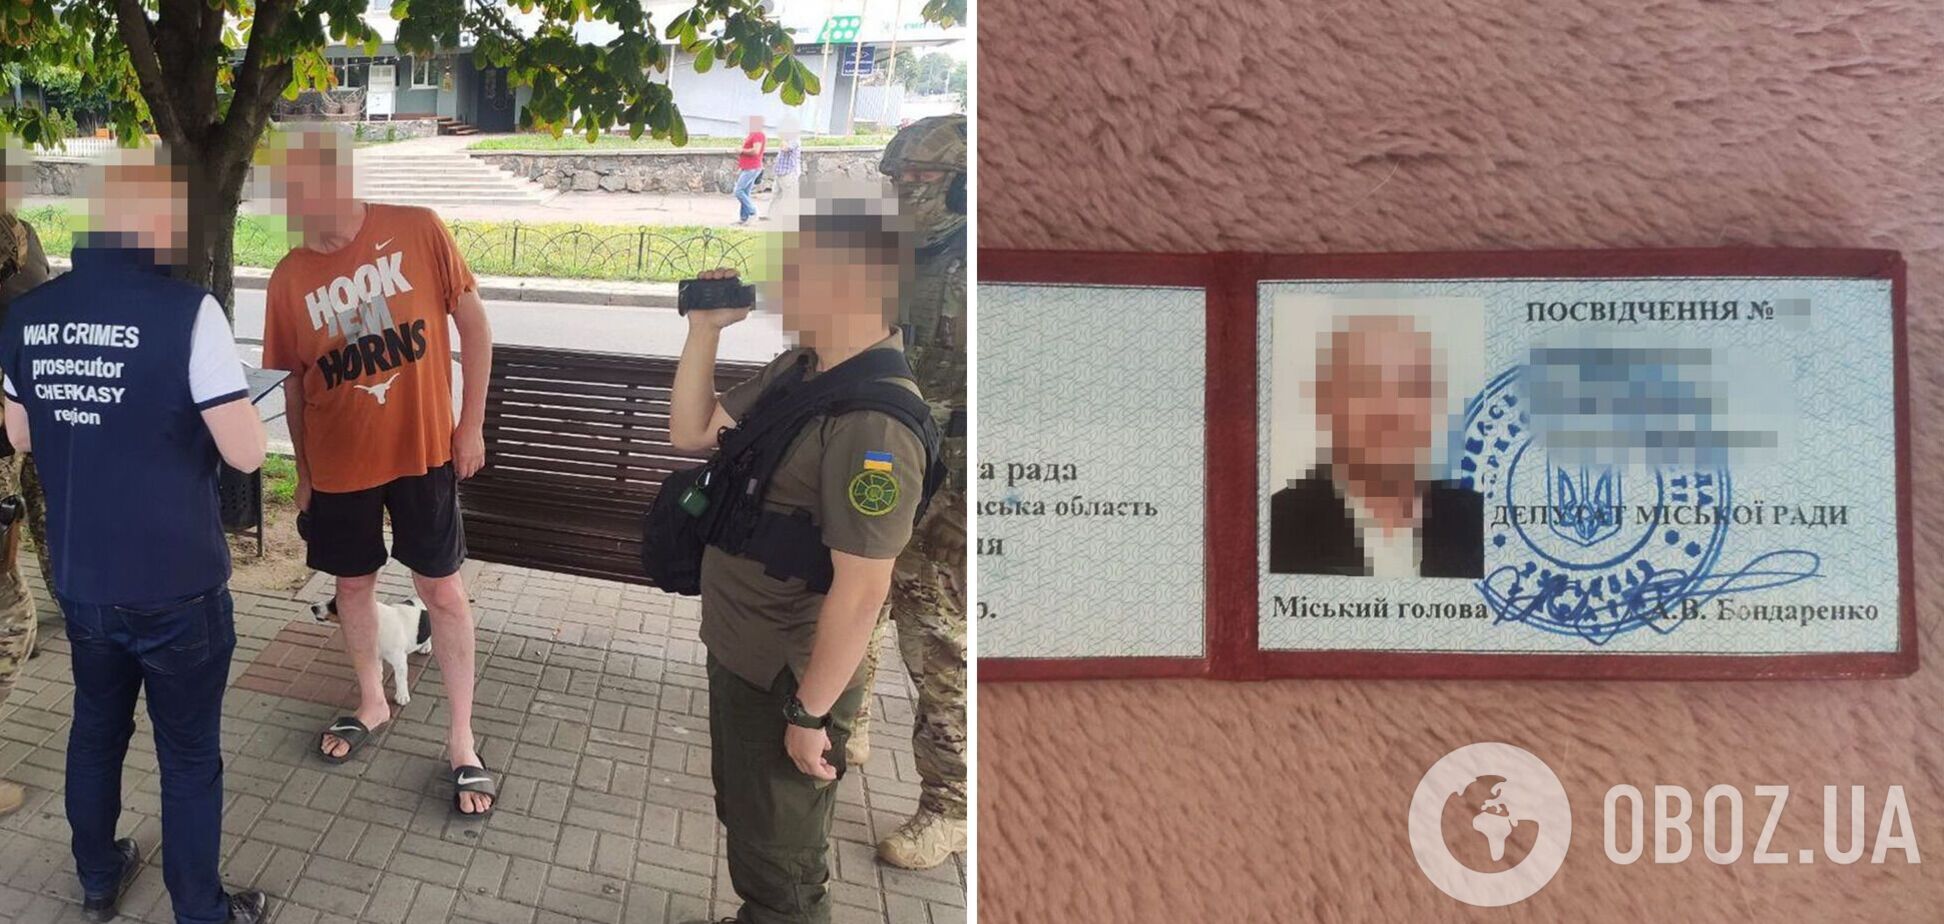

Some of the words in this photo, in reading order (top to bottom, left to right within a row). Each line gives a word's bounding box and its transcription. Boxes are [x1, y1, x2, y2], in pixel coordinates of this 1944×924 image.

[304, 252, 414, 331] HOOK
[1527, 300, 1738, 324] ПОСВІДЧЕННЯ
[23, 323, 59, 346] WAR
[62, 323, 140, 348] CRIMES
[32, 356, 125, 379] prosecutor
[316, 319, 427, 391] HORNS
[35, 383, 126, 403] CHERKASY
[977, 462, 995, 480] а
[1007, 462, 1078, 487] рада
[1055, 495, 1159, 517] область
[1491, 505, 1627, 528] ДЕПУТАТ
[1636, 500, 1765, 525] МІСЬКОЇ
[1772, 504, 1848, 528] РАДИ
[1272, 595, 1389, 618] Міський
[1397, 602, 1489, 619] голова
[1716, 599, 1879, 627] Бондаренко
